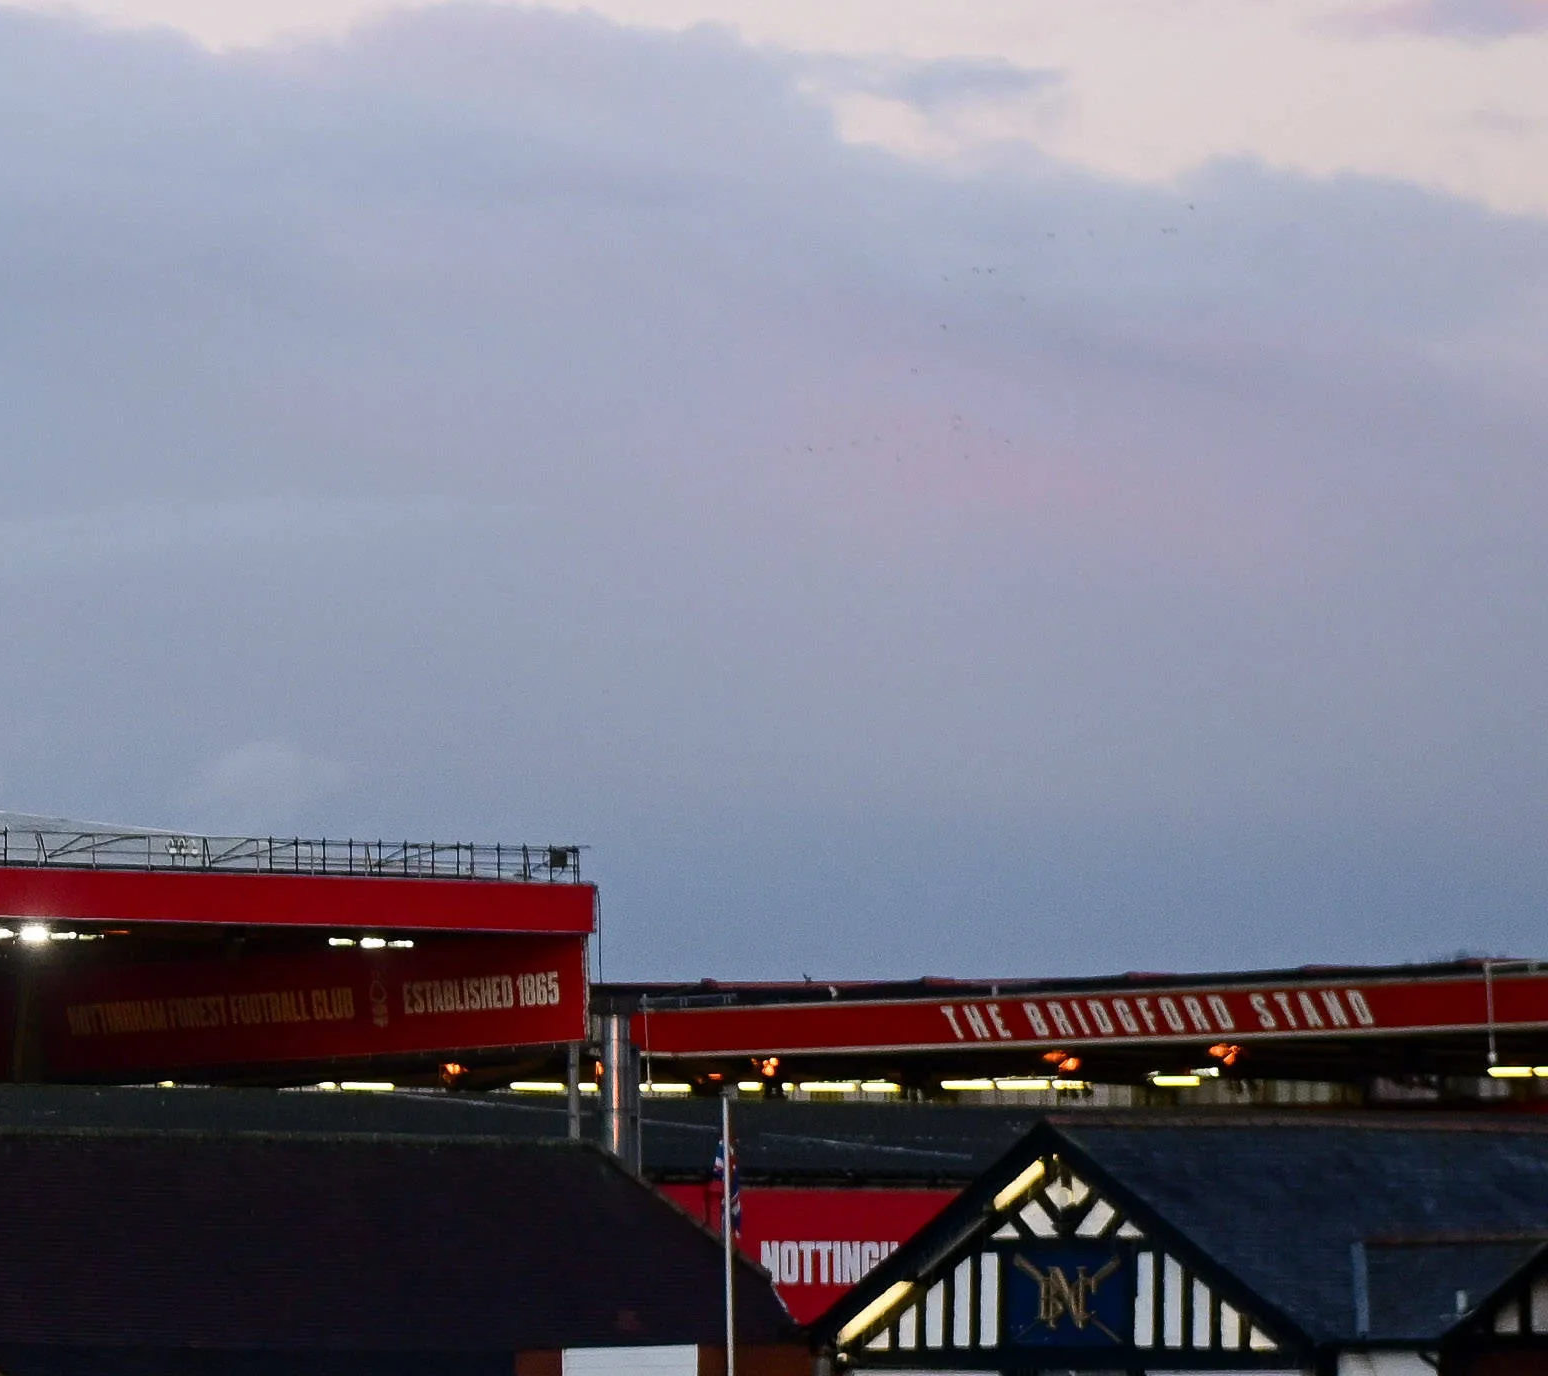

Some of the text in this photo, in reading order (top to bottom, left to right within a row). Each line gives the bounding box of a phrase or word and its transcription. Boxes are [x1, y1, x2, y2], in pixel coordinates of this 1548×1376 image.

[66, 985, 356, 1036] NOTTINGHAM FOREST FOOTBALL CLUB
[403, 970, 560, 1015] ESTABLISHED 1865
[941, 988, 1375, 1041] THE BRIDGFORD STAND
